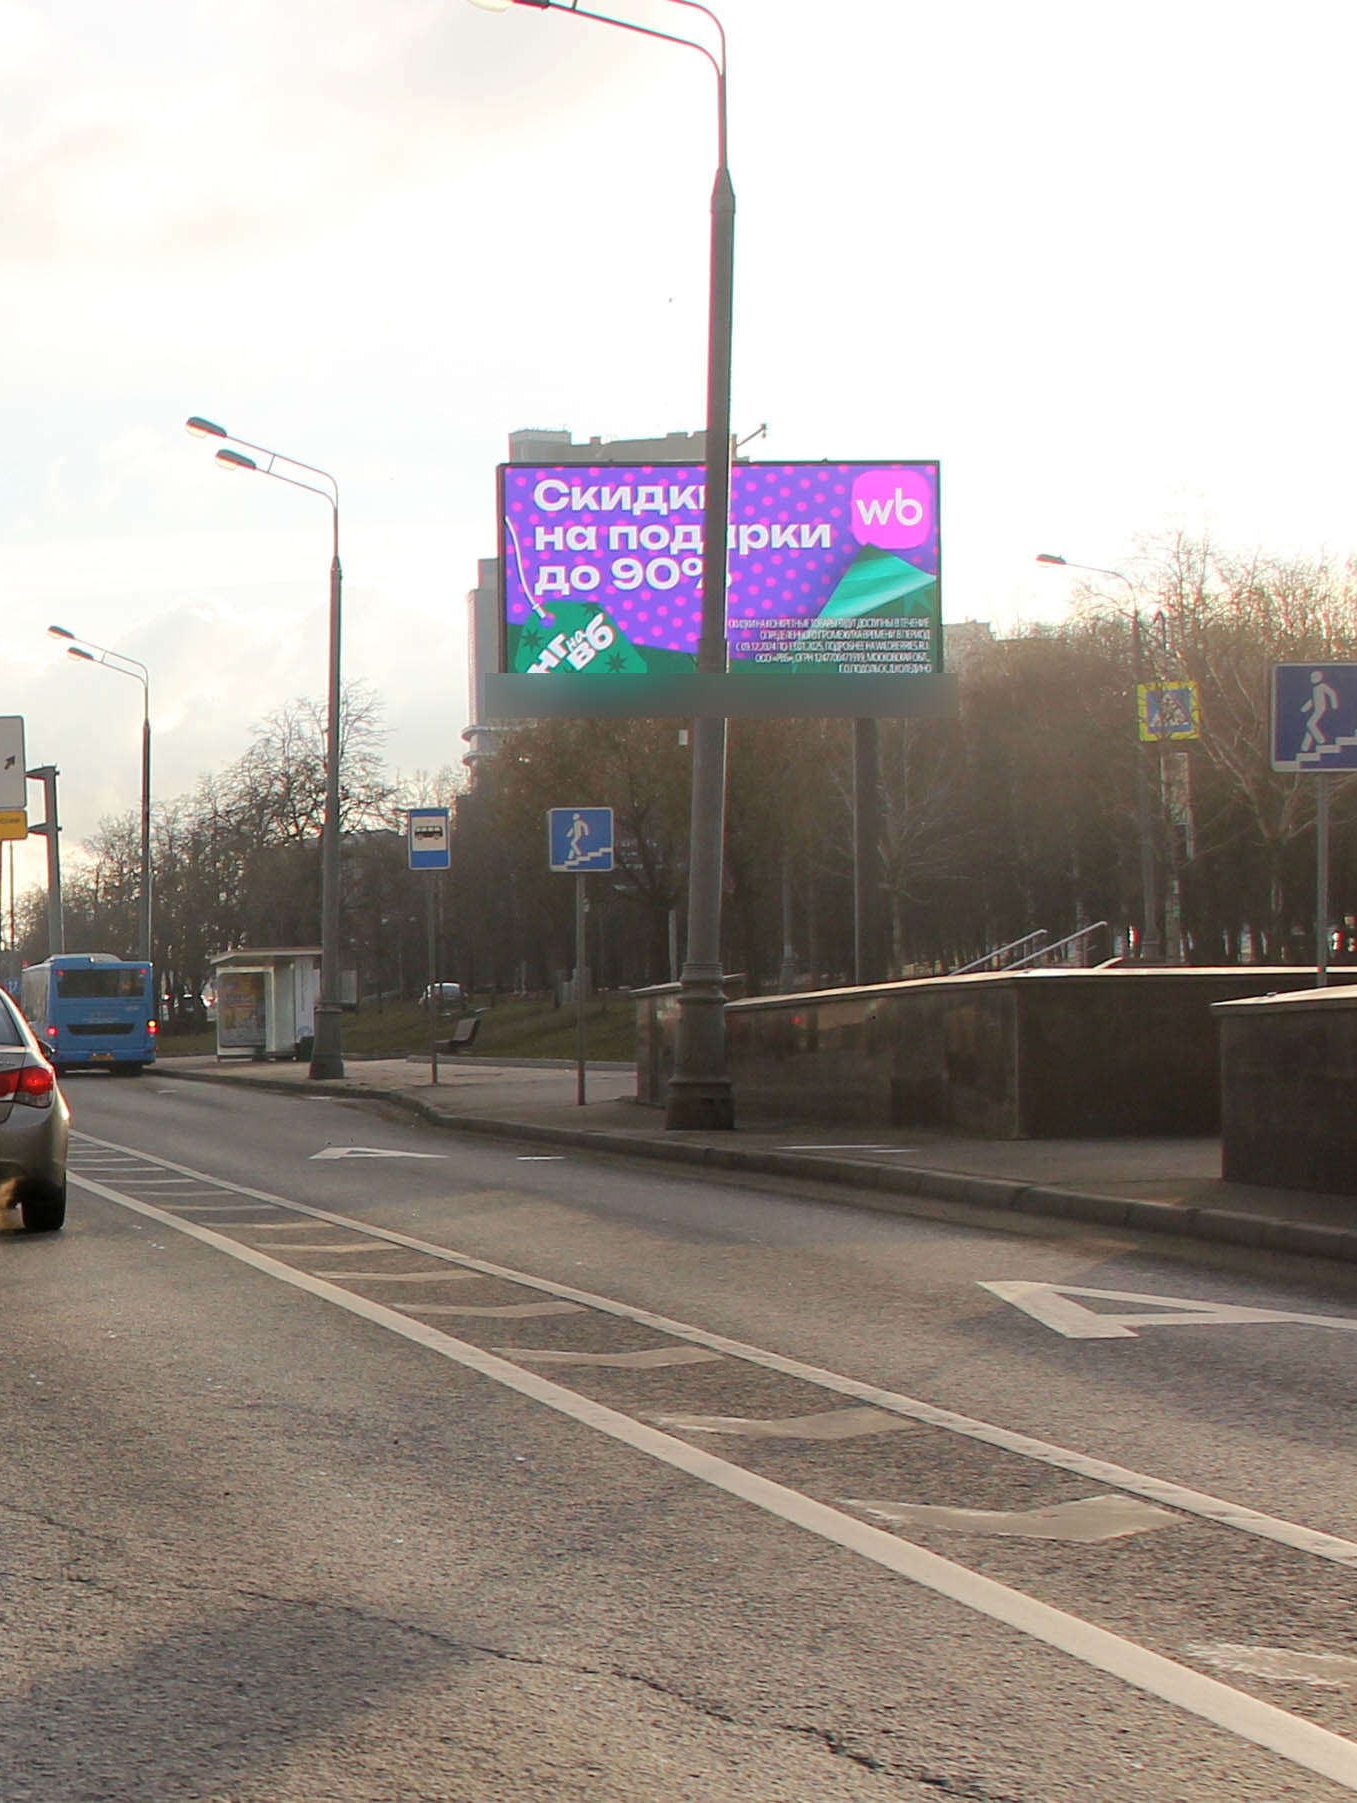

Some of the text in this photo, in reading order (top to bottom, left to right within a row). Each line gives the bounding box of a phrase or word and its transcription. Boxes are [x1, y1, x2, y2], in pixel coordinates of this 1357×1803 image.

[533, 478, 706, 516] Скидк
[856, 487, 924, 527] wb
[534, 524, 598, 552] на
[533, 564, 601, 596] до
